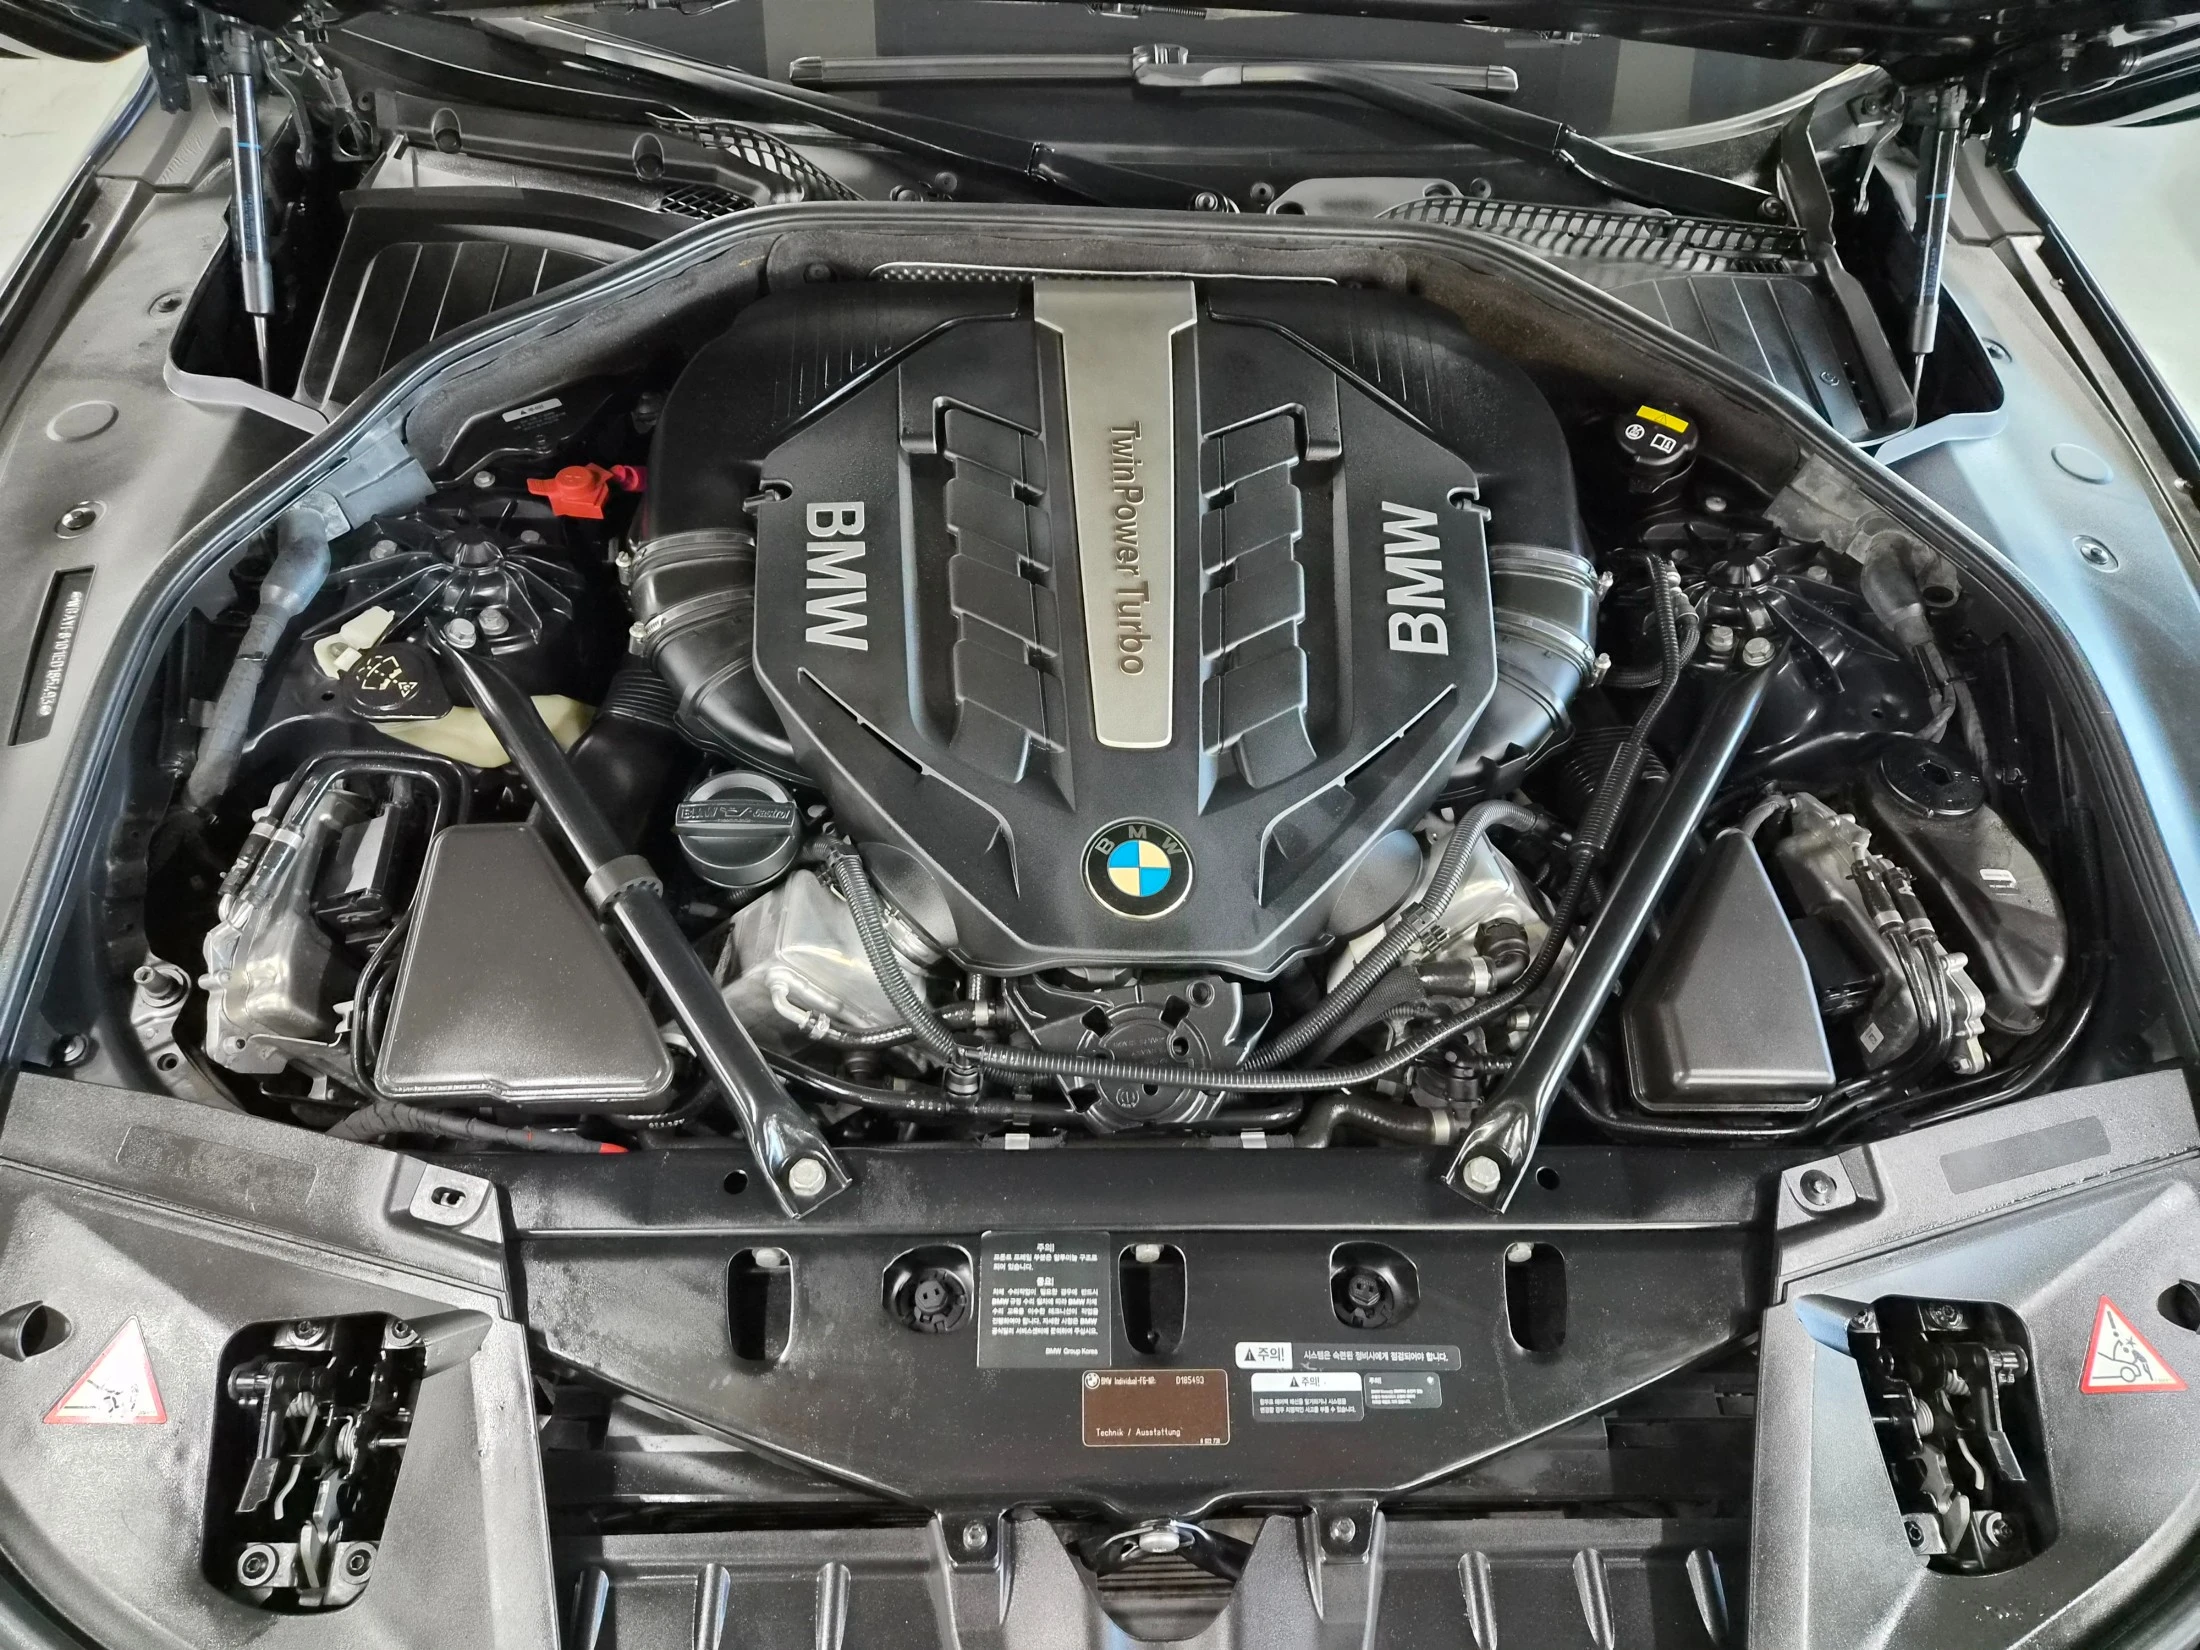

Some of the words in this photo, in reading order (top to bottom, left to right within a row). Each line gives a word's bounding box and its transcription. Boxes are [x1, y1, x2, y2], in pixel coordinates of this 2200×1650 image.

[1110, 421, 1146, 577] TwinPower
[806, 501, 868, 651] BMW
[1382, 501, 1449, 656] BMW
[1116, 580, 1152, 676] Turbo
[752, 808, 791, 820] Castrol
[1094, 825, 1183, 856] BMW
[1007, 1263, 1034, 1271] 있습니다.
[1045, 1347, 1062, 1356] BMW
[1063, 1347, 1081, 1356] Group
[1081, 1347, 1099, 1356] Korea
[1257, 1347, 1285, 1362] 주의!
[1303, 1350, 1331, 1361] 시스템은
[1332, 1350, 1354, 1361] 숙련된
[1354, 1350, 1389, 1361] 정비사에게
[1425, 1351, 1449, 1362] 합니다.
[1175, 1375, 1205, 1385] D185493
[1301, 1376, 1320, 1387] 주의!
[1096, 1428, 1124, 1437] Technik
[1135, 1428, 1181, 1438] Ausstattung
